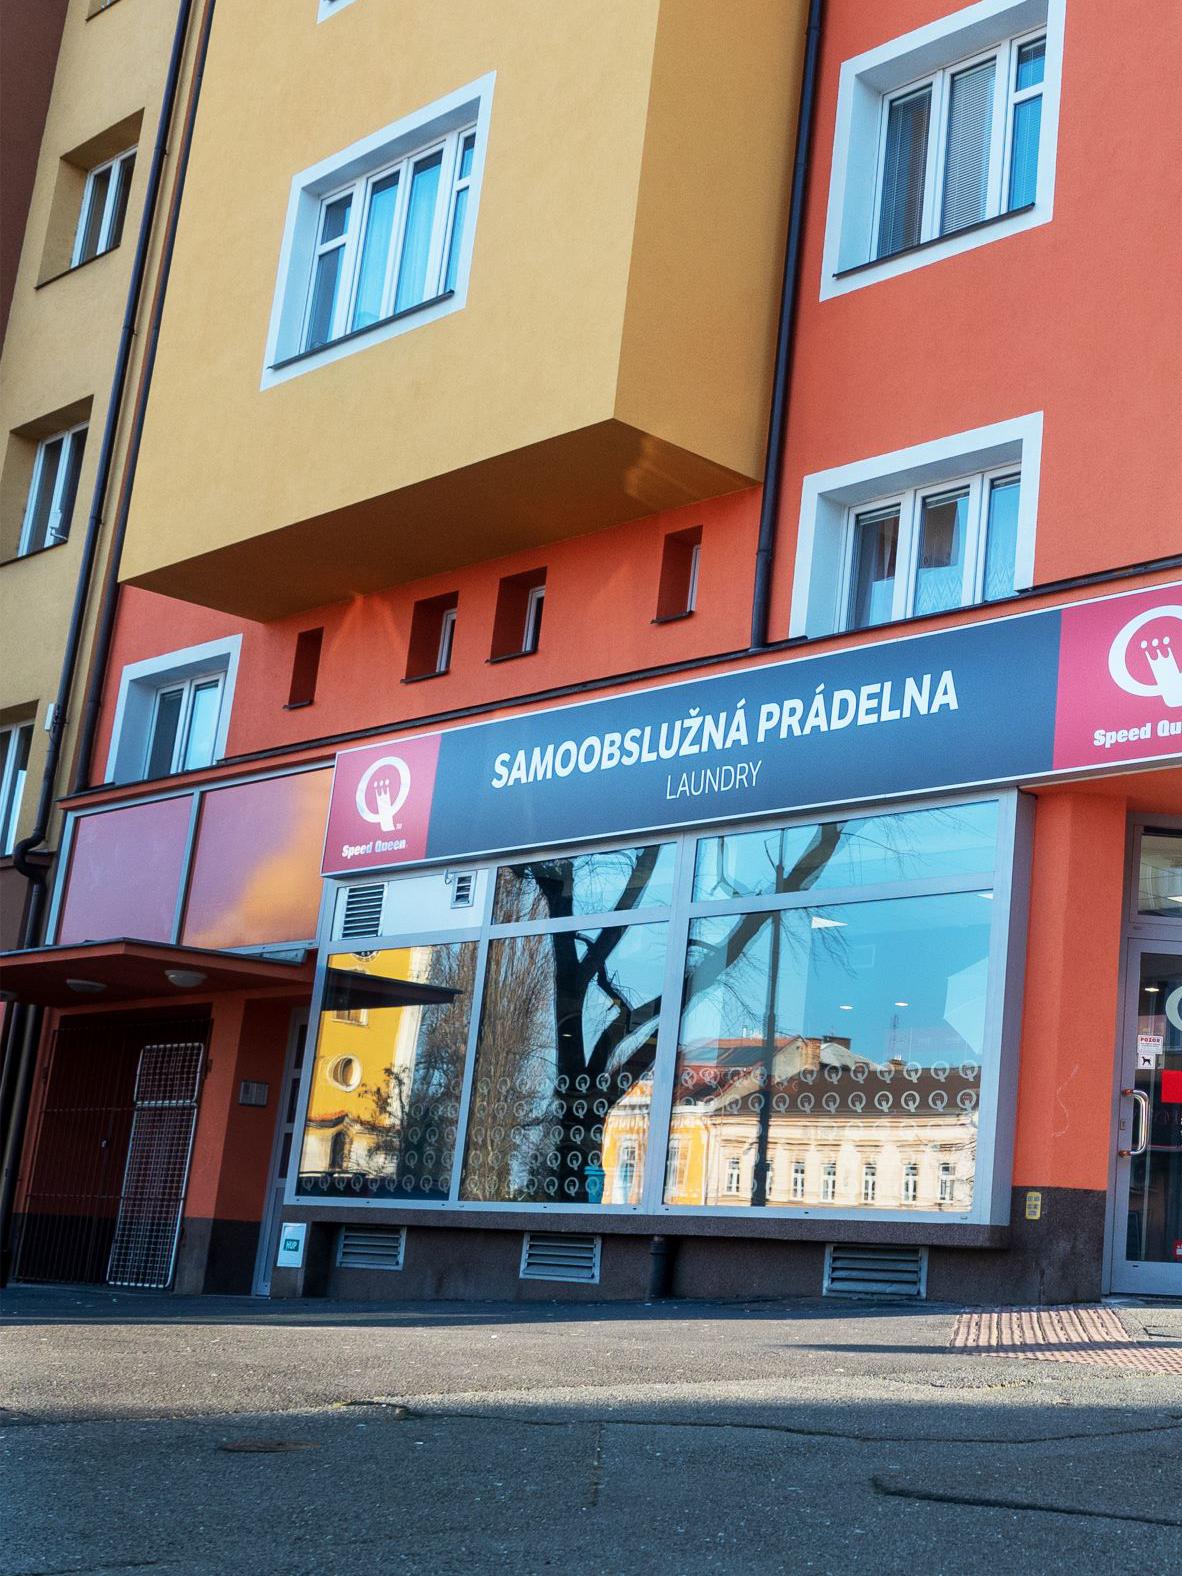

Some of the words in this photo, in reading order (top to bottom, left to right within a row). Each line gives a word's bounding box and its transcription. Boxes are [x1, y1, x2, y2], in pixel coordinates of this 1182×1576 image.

[491, 698, 749, 789] SAMOOBSLUŽNÁ
[757, 669, 959, 743] PRÁDELNA
[1093, 723, 1151, 748] Speed
[666, 760, 763, 800] LAUNDRY
[341, 842, 373, 859] Speed
[375, 839, 406, 853] Queen
